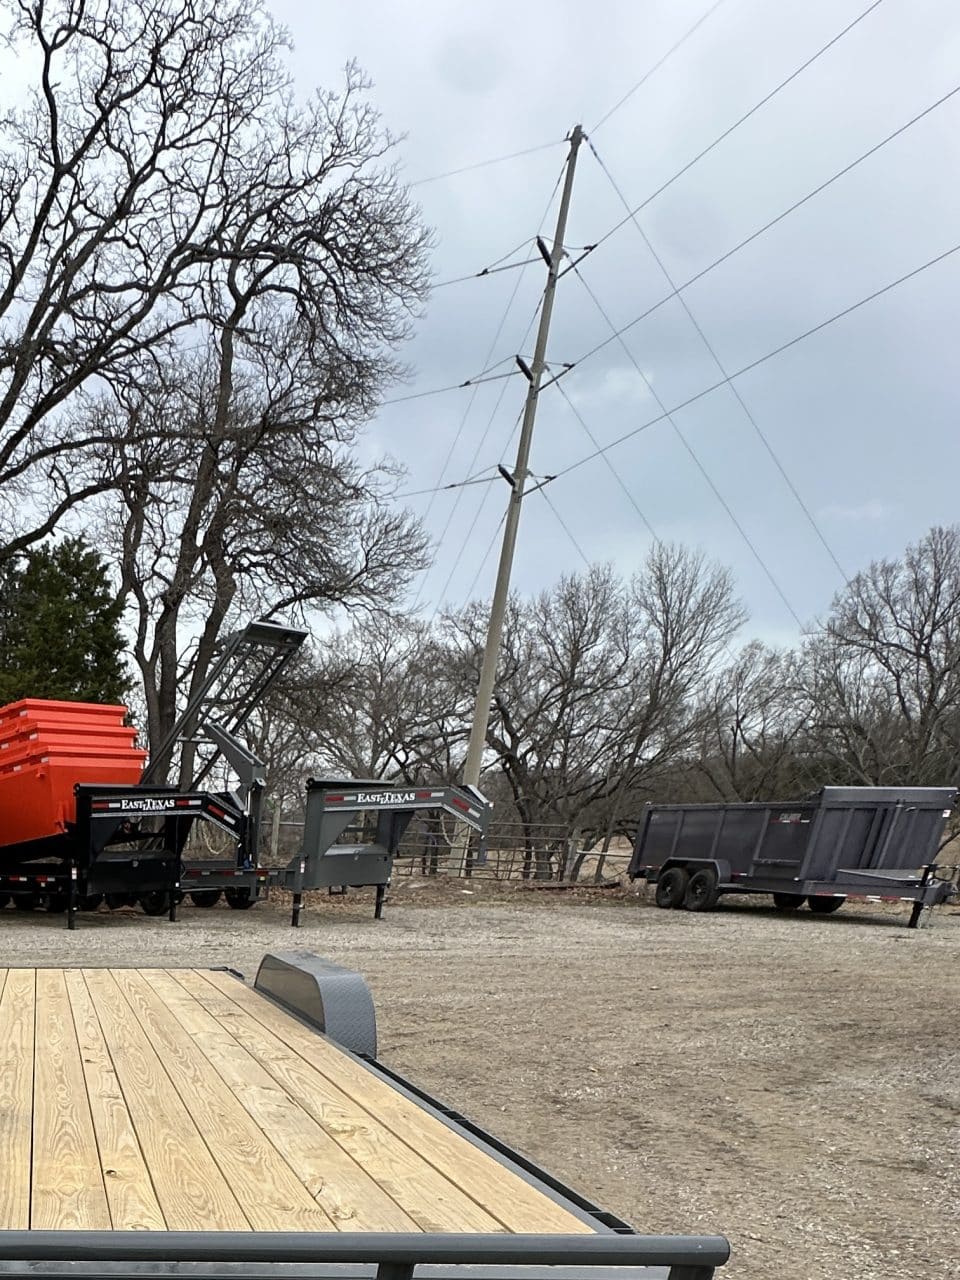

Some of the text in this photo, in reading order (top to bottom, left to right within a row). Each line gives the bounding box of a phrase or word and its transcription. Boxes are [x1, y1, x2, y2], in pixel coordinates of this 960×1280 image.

[357, 793, 383, 803] EAST
[383, 792, 416, 802] TEXAS
[121, 799, 144, 809] EAST
[144, 799, 175, 808] TEXAS
